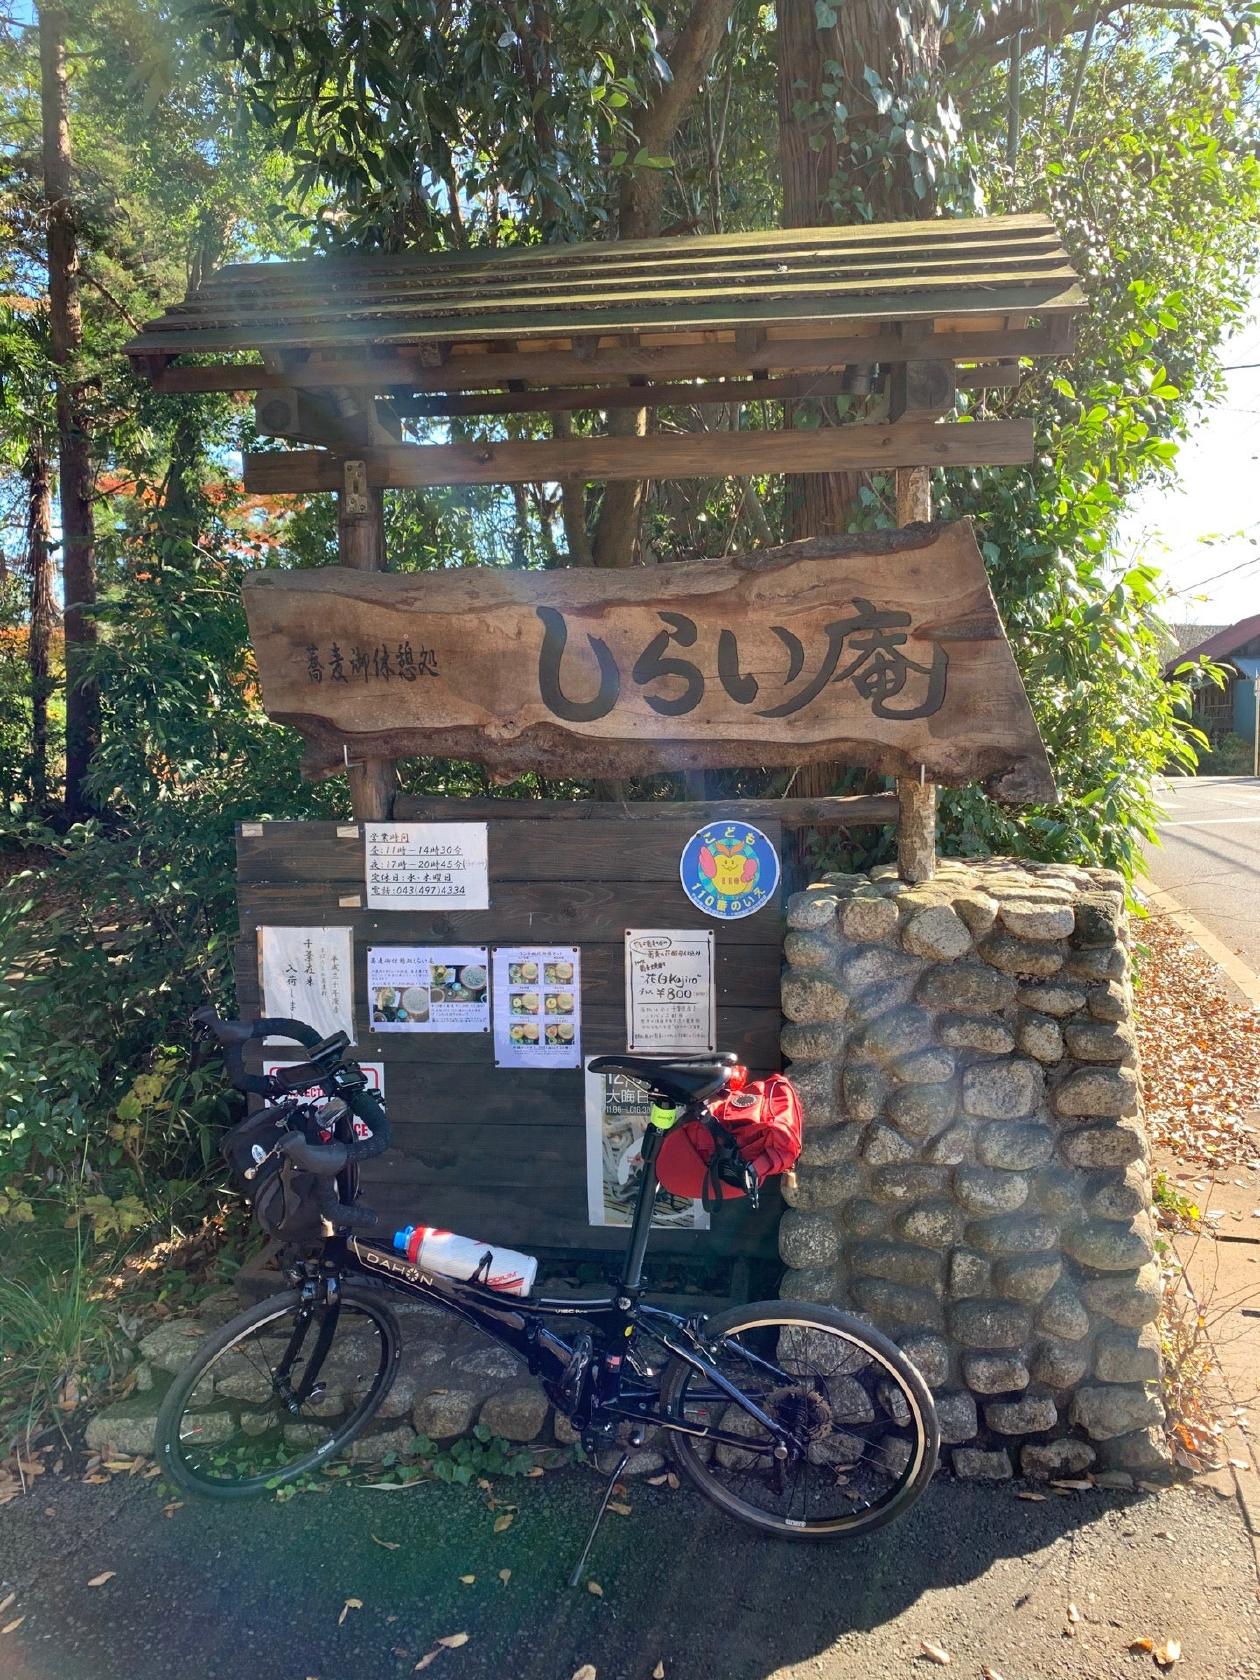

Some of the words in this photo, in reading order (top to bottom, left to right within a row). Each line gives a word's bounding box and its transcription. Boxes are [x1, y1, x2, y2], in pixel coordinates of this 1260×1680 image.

[535, 597, 952, 722] しらい庵
[703, 826, 755, 845] こども
[606, 1089, 649, 1104] 大晦日
[366, 1253, 434, 1287] DAHON
